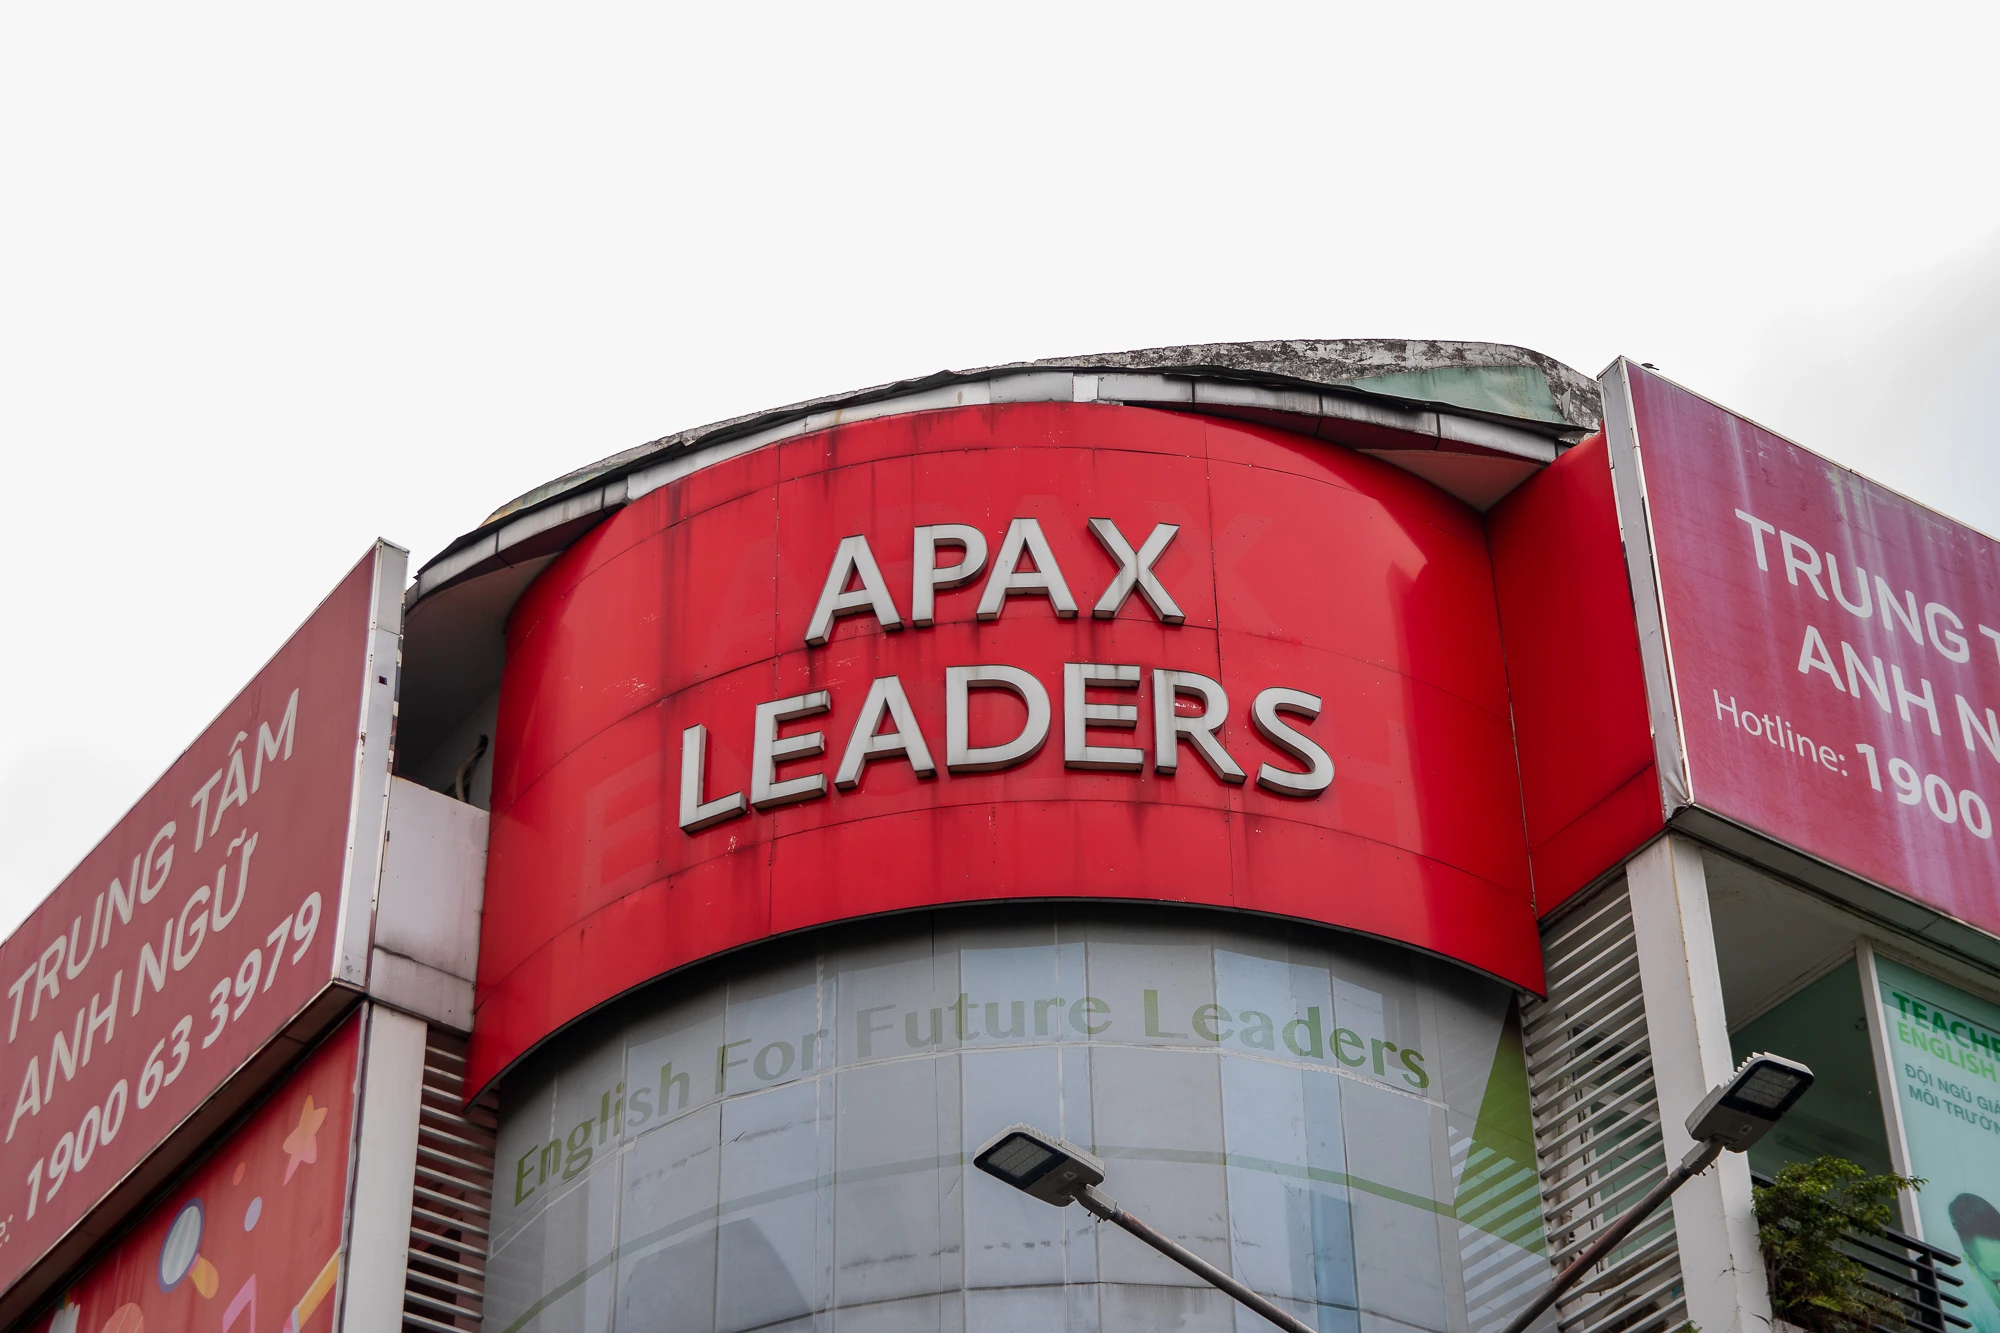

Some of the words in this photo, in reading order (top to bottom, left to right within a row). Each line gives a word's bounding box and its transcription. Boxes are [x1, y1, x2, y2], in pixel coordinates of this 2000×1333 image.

[804, 517, 1185, 647] APAX
[1735, 507, 1971, 664] TRUNG
[678, 662, 1335, 834] LEADERS
[1797, 624, 1942, 737] ANH
[1712, 688, 1848, 778] Hotline:
[1855, 743, 1993, 840] 1900
[7, 820, 178, 1044] TRUNG
[189, 687, 300, 853] TÂM
[5, 970, 122, 1144] ANH
[132, 827, 259, 1017] NGỮ
[26, 1078, 129, 1222] 1900
[137, 1014, 193, 1110] 63
[202, 891, 322, 1050] 3979
[1897, 1020, 1997, 1083] ENGLISH
[514, 1061, 690, 1208] English
[714, 1027, 829, 1096] For
[856, 992, 1112, 1058] Future
[1143, 988, 1430, 1089] Leaders
